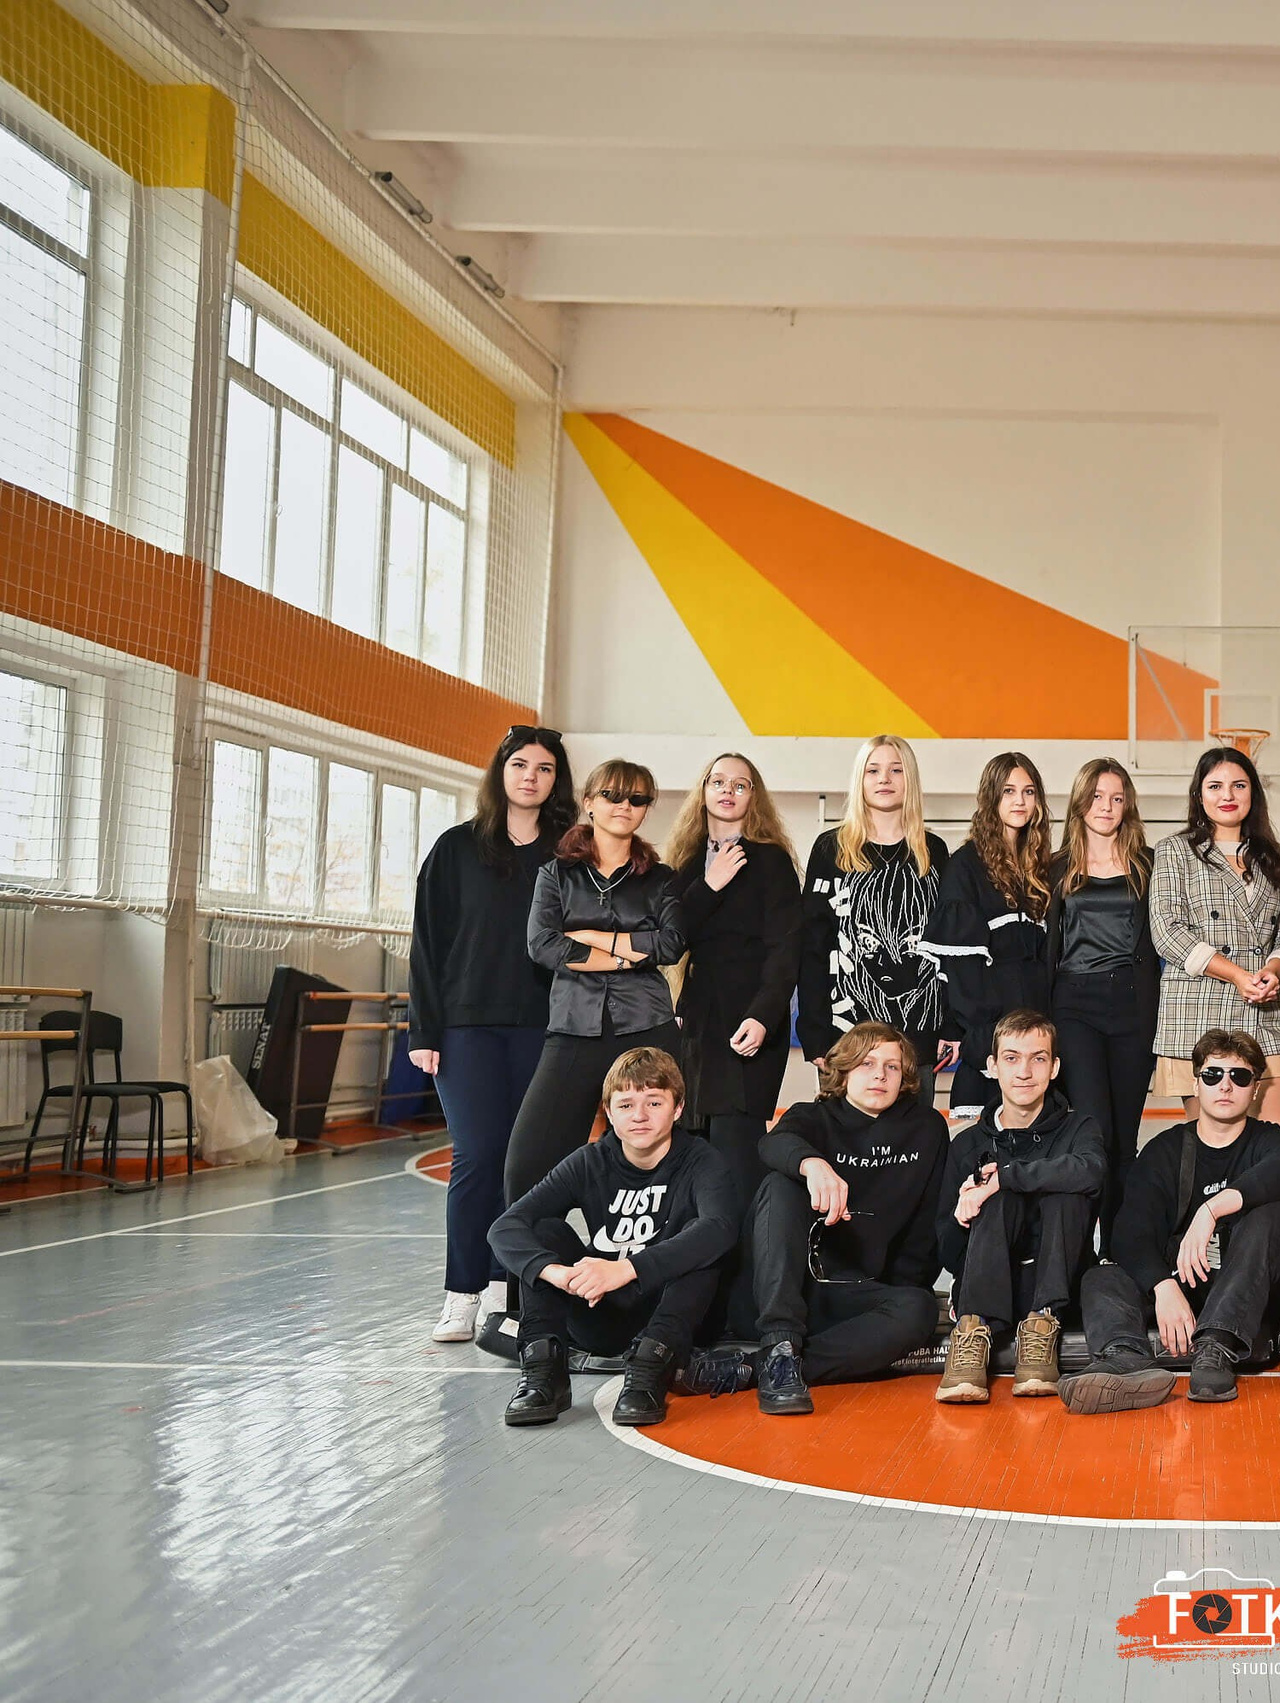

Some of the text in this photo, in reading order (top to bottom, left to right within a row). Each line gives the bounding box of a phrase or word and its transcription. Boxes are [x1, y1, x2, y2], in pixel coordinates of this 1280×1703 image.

[251, 1022, 271, 1069] SENAT
[836, 1152, 919, 1168] UKRAINIAN
[871, 1146, 891, 1156] I'M
[608, 1185, 668, 1216] JUST
[612, 1215, 654, 1243] DO
